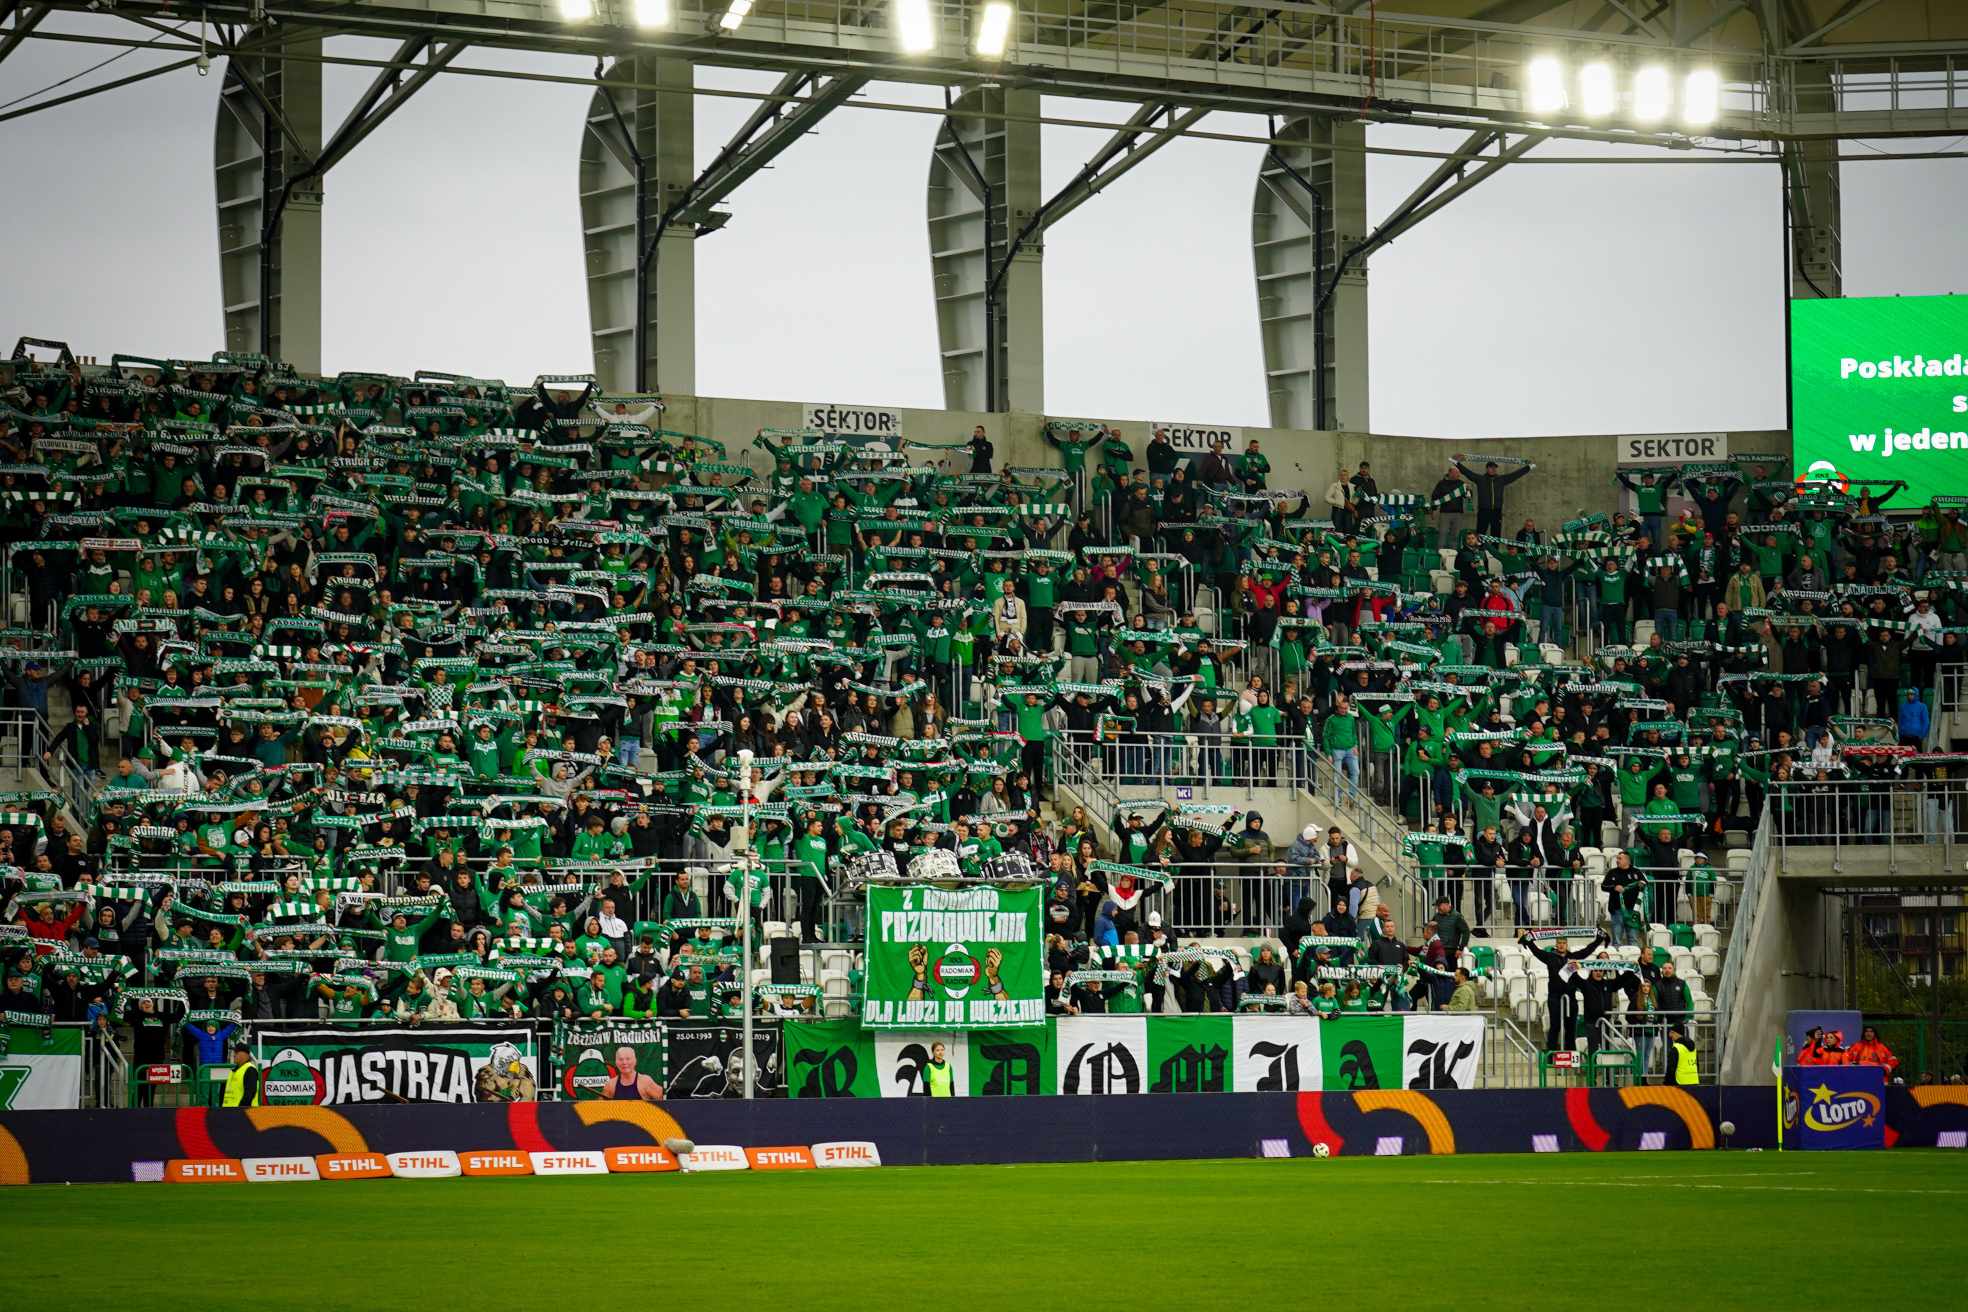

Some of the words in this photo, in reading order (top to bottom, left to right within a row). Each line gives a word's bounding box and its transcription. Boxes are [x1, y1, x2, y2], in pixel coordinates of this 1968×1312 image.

[814, 409, 892, 431] SEKTOR
[1162, 426, 1233, 449] SEKTOR
[1631, 438, 1714, 457] SEKTOR
[1848, 434, 1877, 452] w
[902, 890, 913, 910] Z
[881, 912, 1028, 943] POZDROWIENIA
[865, 1000, 893, 1023] DLA
[613, 1028, 661, 1044] Radulski
[171, 1068, 181, 1079] 12
[266, 1083, 315, 1093] RADOMIAK
[1819, 1098, 1867, 1124] LOTTO
[182, 1163, 237, 1177] STIHL
[255, 1163, 311, 1176] STIHL
[329, 1157, 383, 1172] STIHL
[397, 1156, 450, 1169] STIHL
[470, 1155, 523, 1169] STIHL
[543, 1155, 596, 1169] STIHL
[617, 1152, 669, 1166] STIHL
[688, 1149, 738, 1163] STIHL
[757, 1151, 807, 1164] STIHL
[825, 1145, 873, 1161] STIHL
